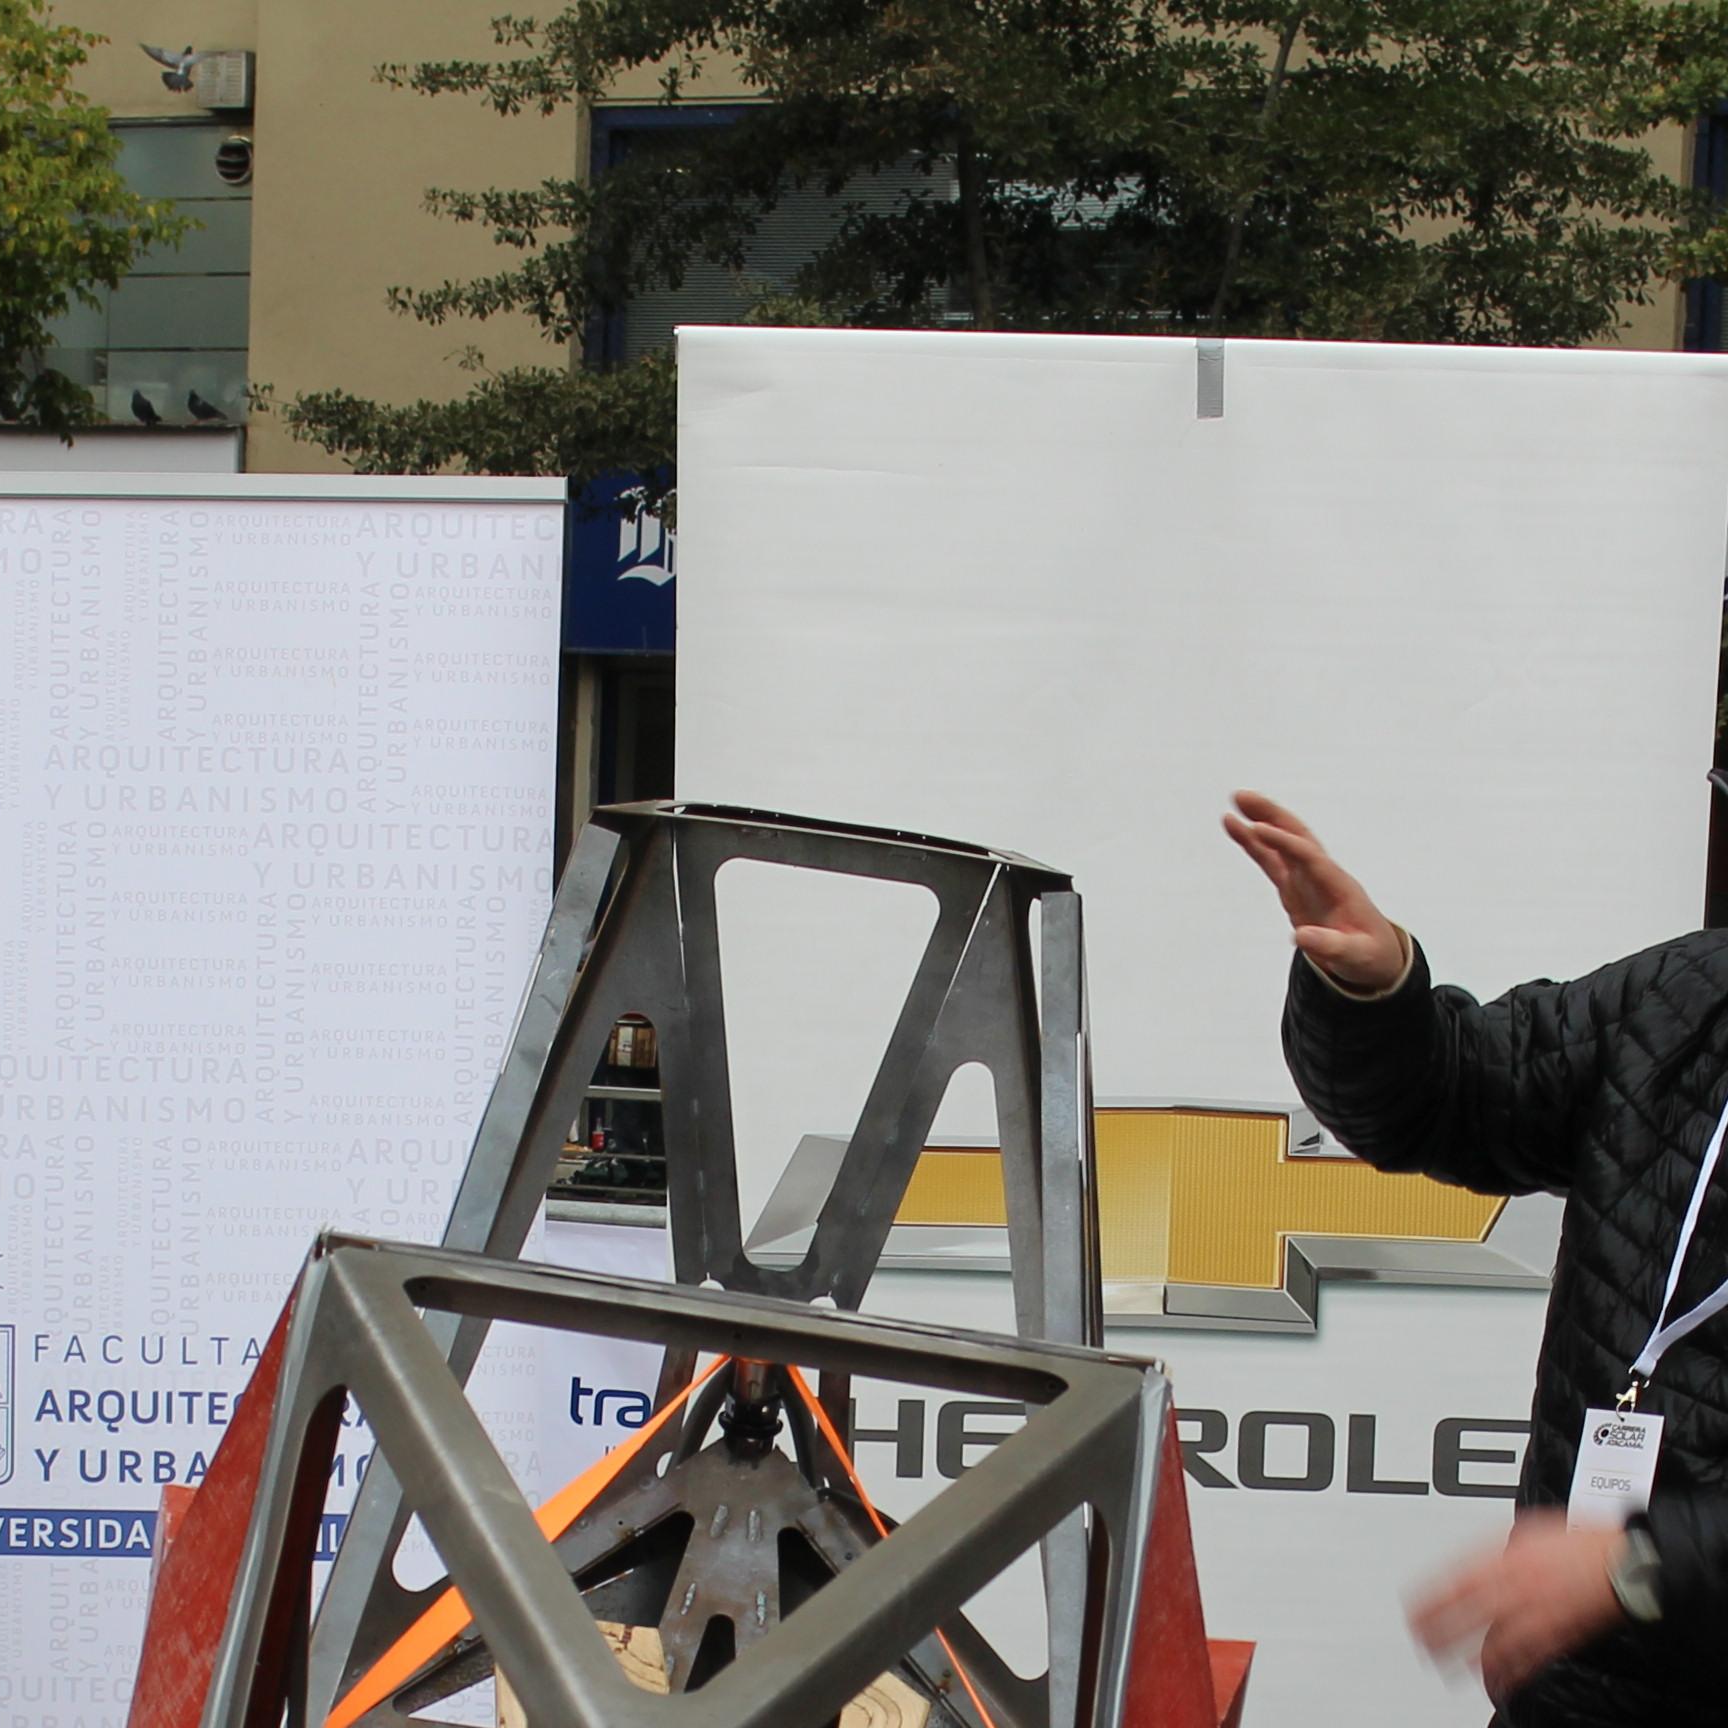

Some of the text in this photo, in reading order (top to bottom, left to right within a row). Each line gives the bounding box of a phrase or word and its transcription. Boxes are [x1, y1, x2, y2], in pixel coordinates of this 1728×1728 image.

[357, 551, 375, 578] Y
[80, 726, 99, 742] Y
[187, 727, 207, 743] Y
[44, 784, 64, 812] Y
[385, 798, 406, 814] Y
[253, 861, 273, 890] Y
[84, 1037, 105, 1053] Y
[283, 1109, 305, 1124] Y
[33, 1334, 261, 1366] FACULTA
[570, 1376, 652, 1429] tra
[1610, 1431, 1645, 1442] SOLAR
[851, 1396, 1533, 1502] HEROLE
[35, 1448, 60, 1482] Y
[1590, 1476, 1631, 1491] EQUIPOS
